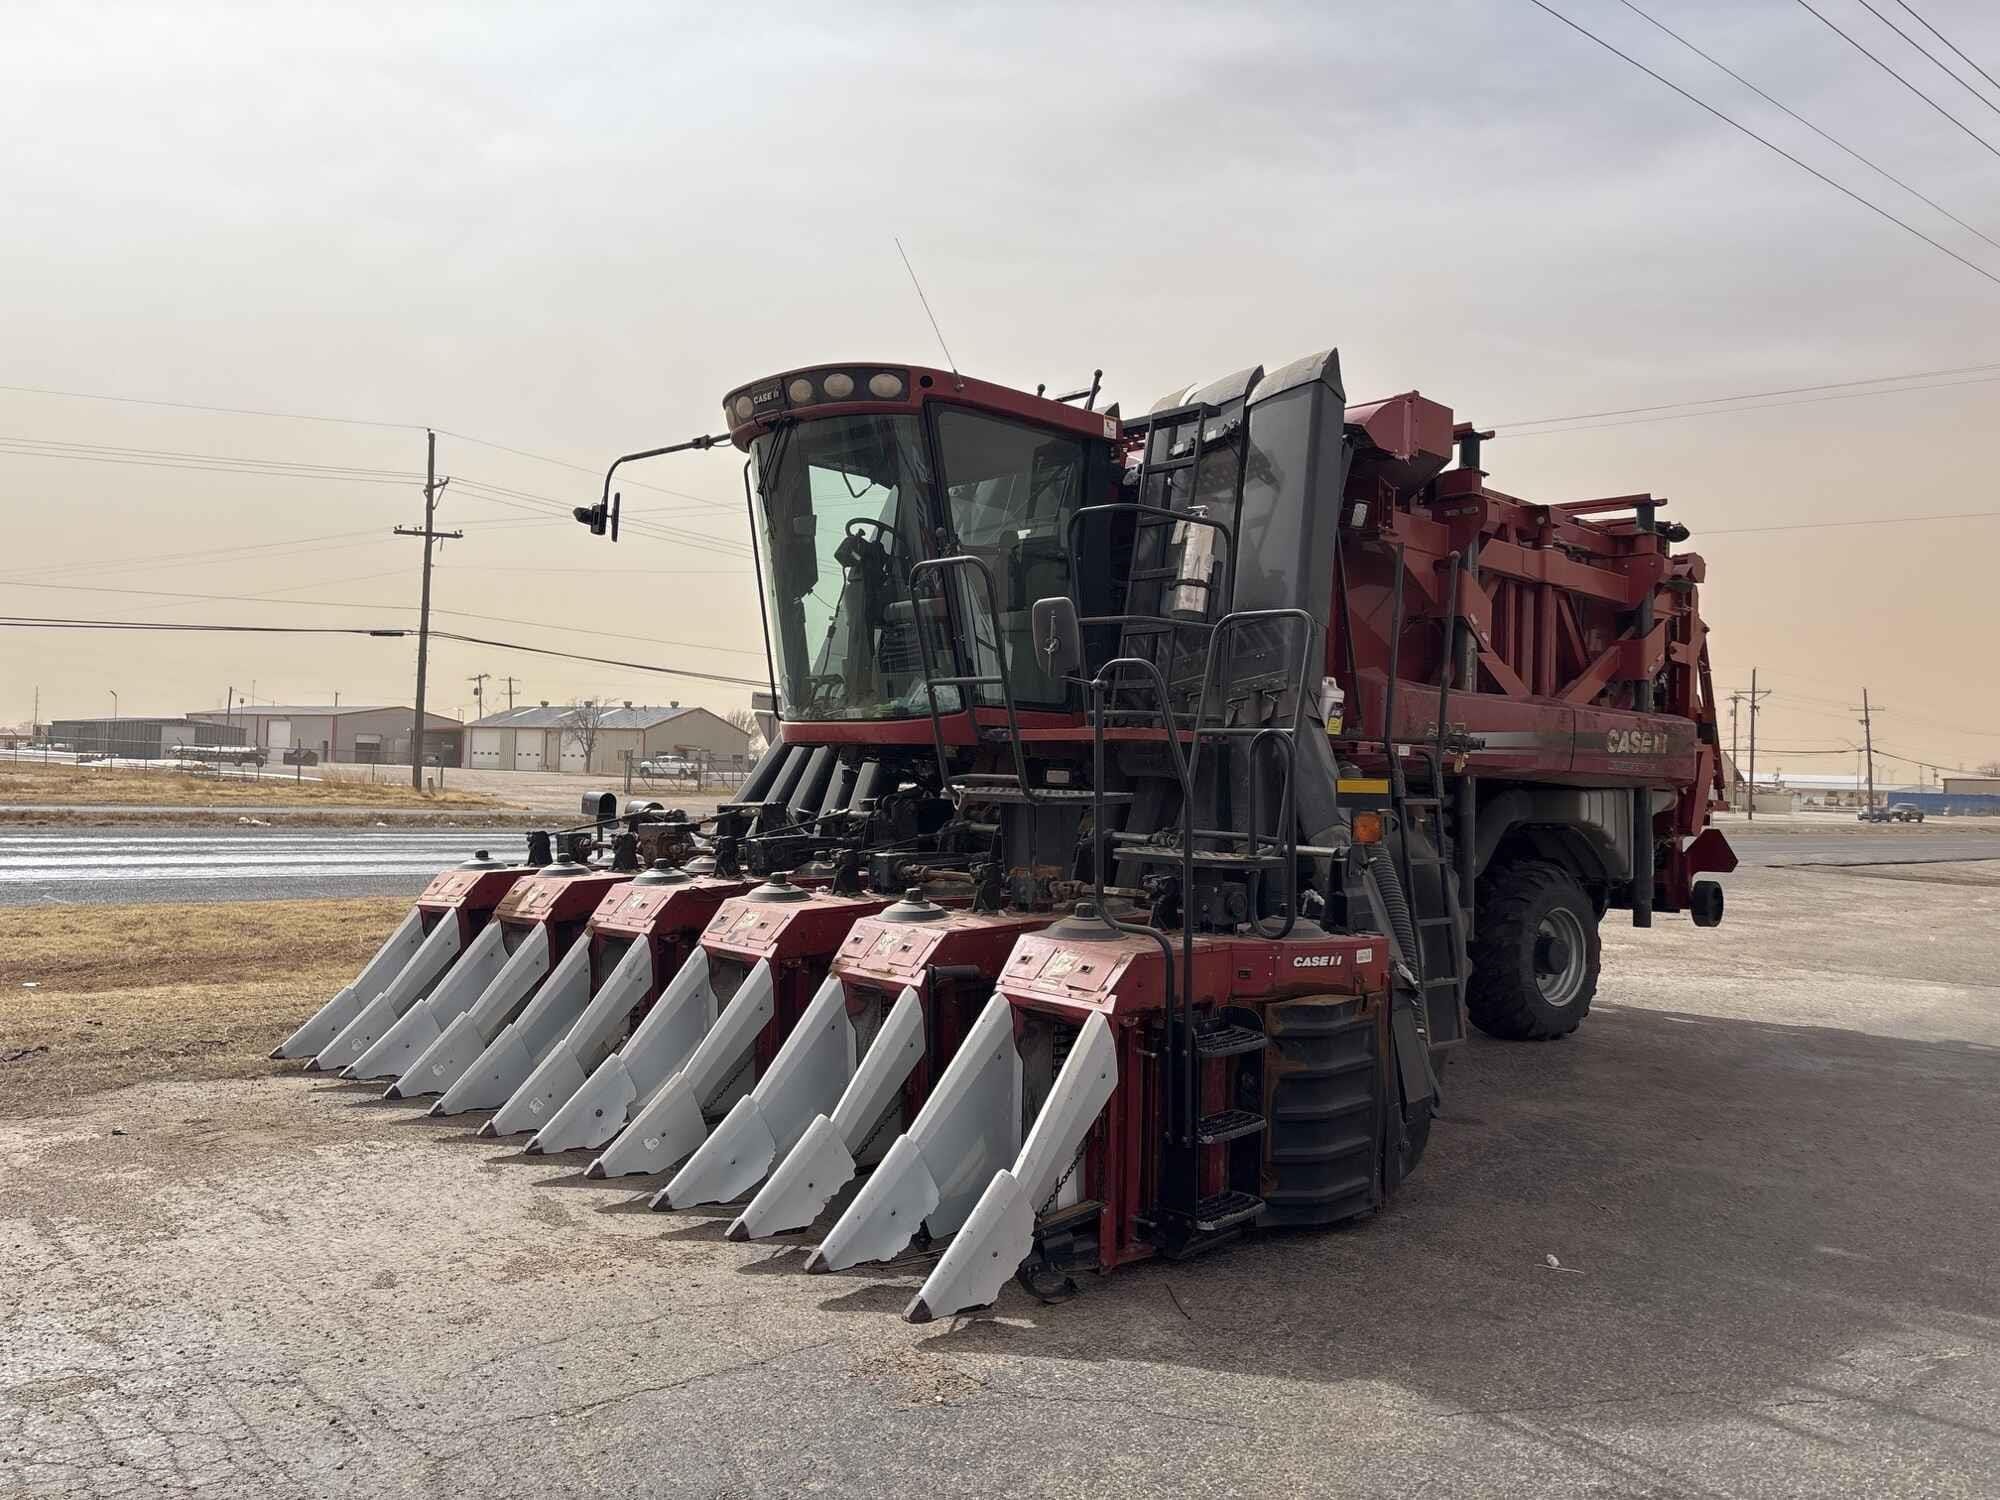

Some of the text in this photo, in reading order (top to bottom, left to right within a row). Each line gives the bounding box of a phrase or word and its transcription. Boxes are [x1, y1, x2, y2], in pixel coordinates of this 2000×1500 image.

[753, 391, 772, 405] CASE
[1607, 729, 1652, 754] CASE
[1293, 956, 1329, 967] CASE
